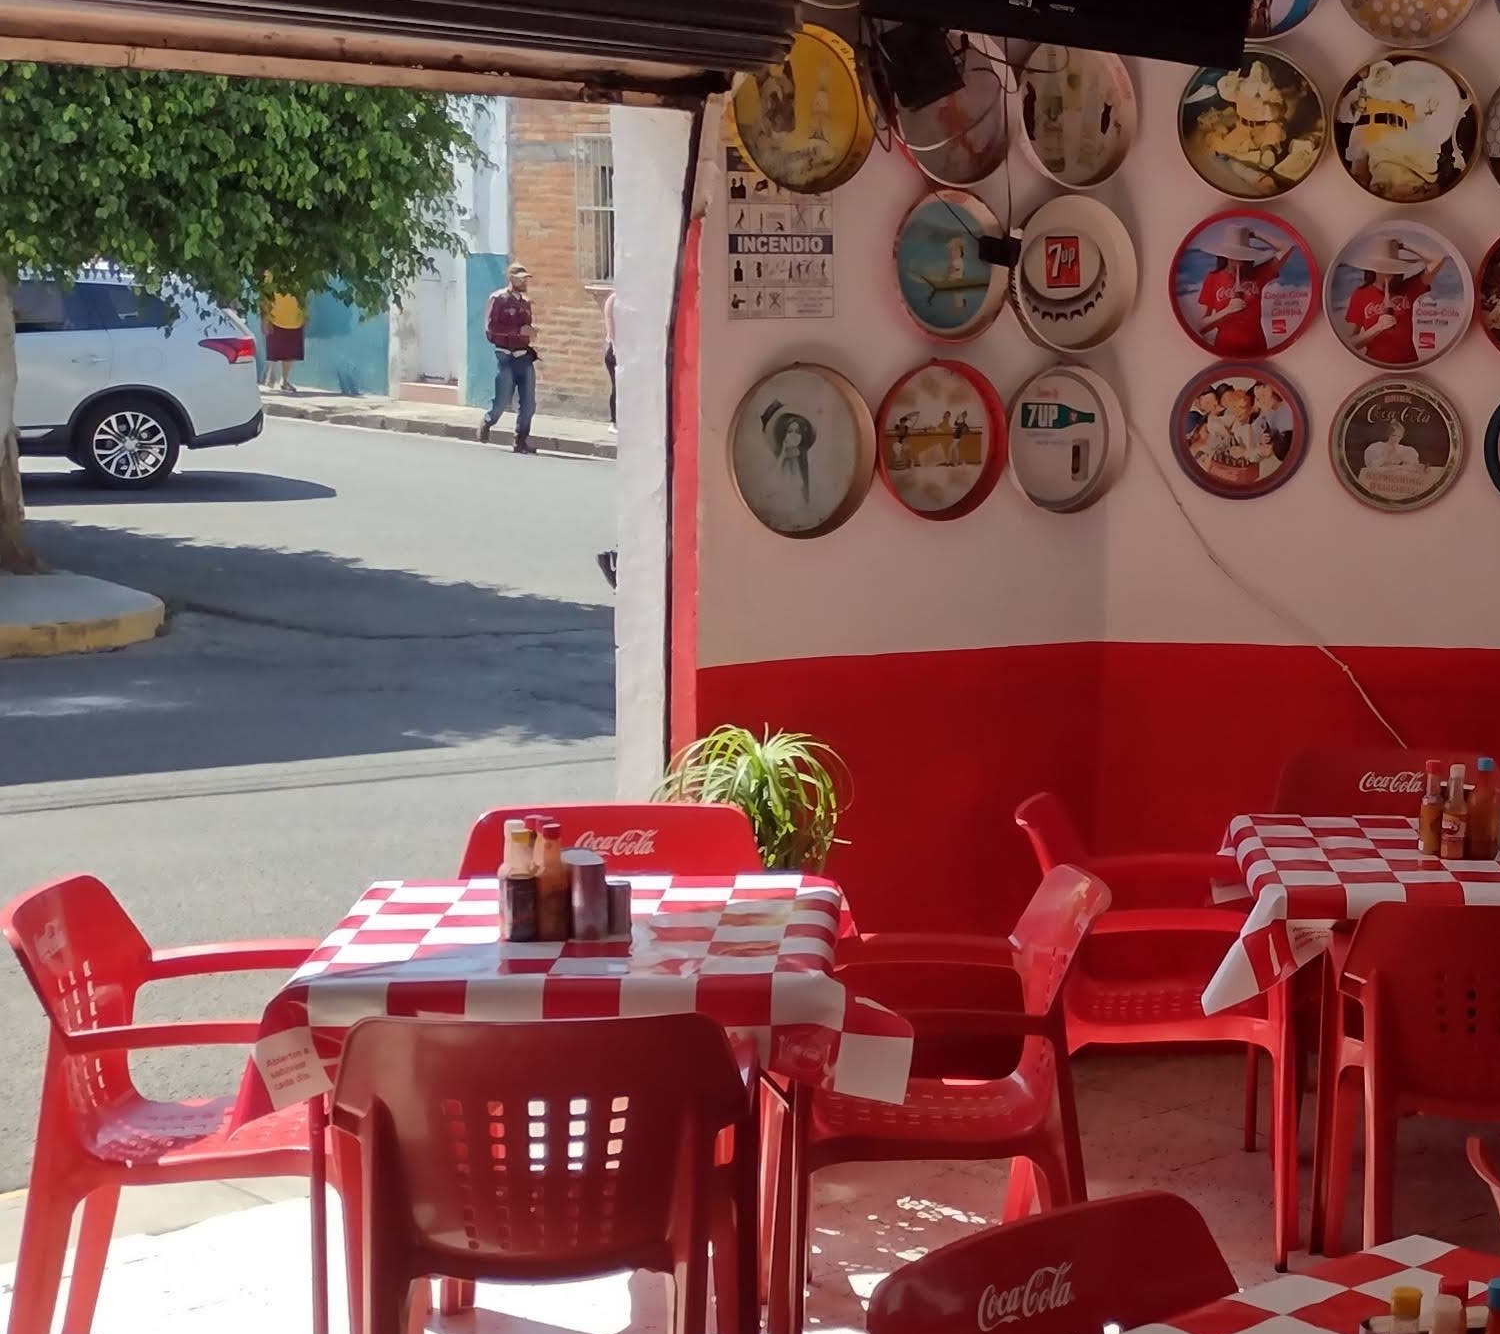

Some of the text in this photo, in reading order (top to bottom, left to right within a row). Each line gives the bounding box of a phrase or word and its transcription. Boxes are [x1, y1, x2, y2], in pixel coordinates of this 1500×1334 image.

[737, 236, 824, 253] INCENDIO
[1027, 405, 1059, 427] 7UP
[1358, 771, 1424, 794] Coca-Cola
[575, 829, 659, 856] Coca-Cola
[977, 1262, 1074, 1331] Coca-Cola
